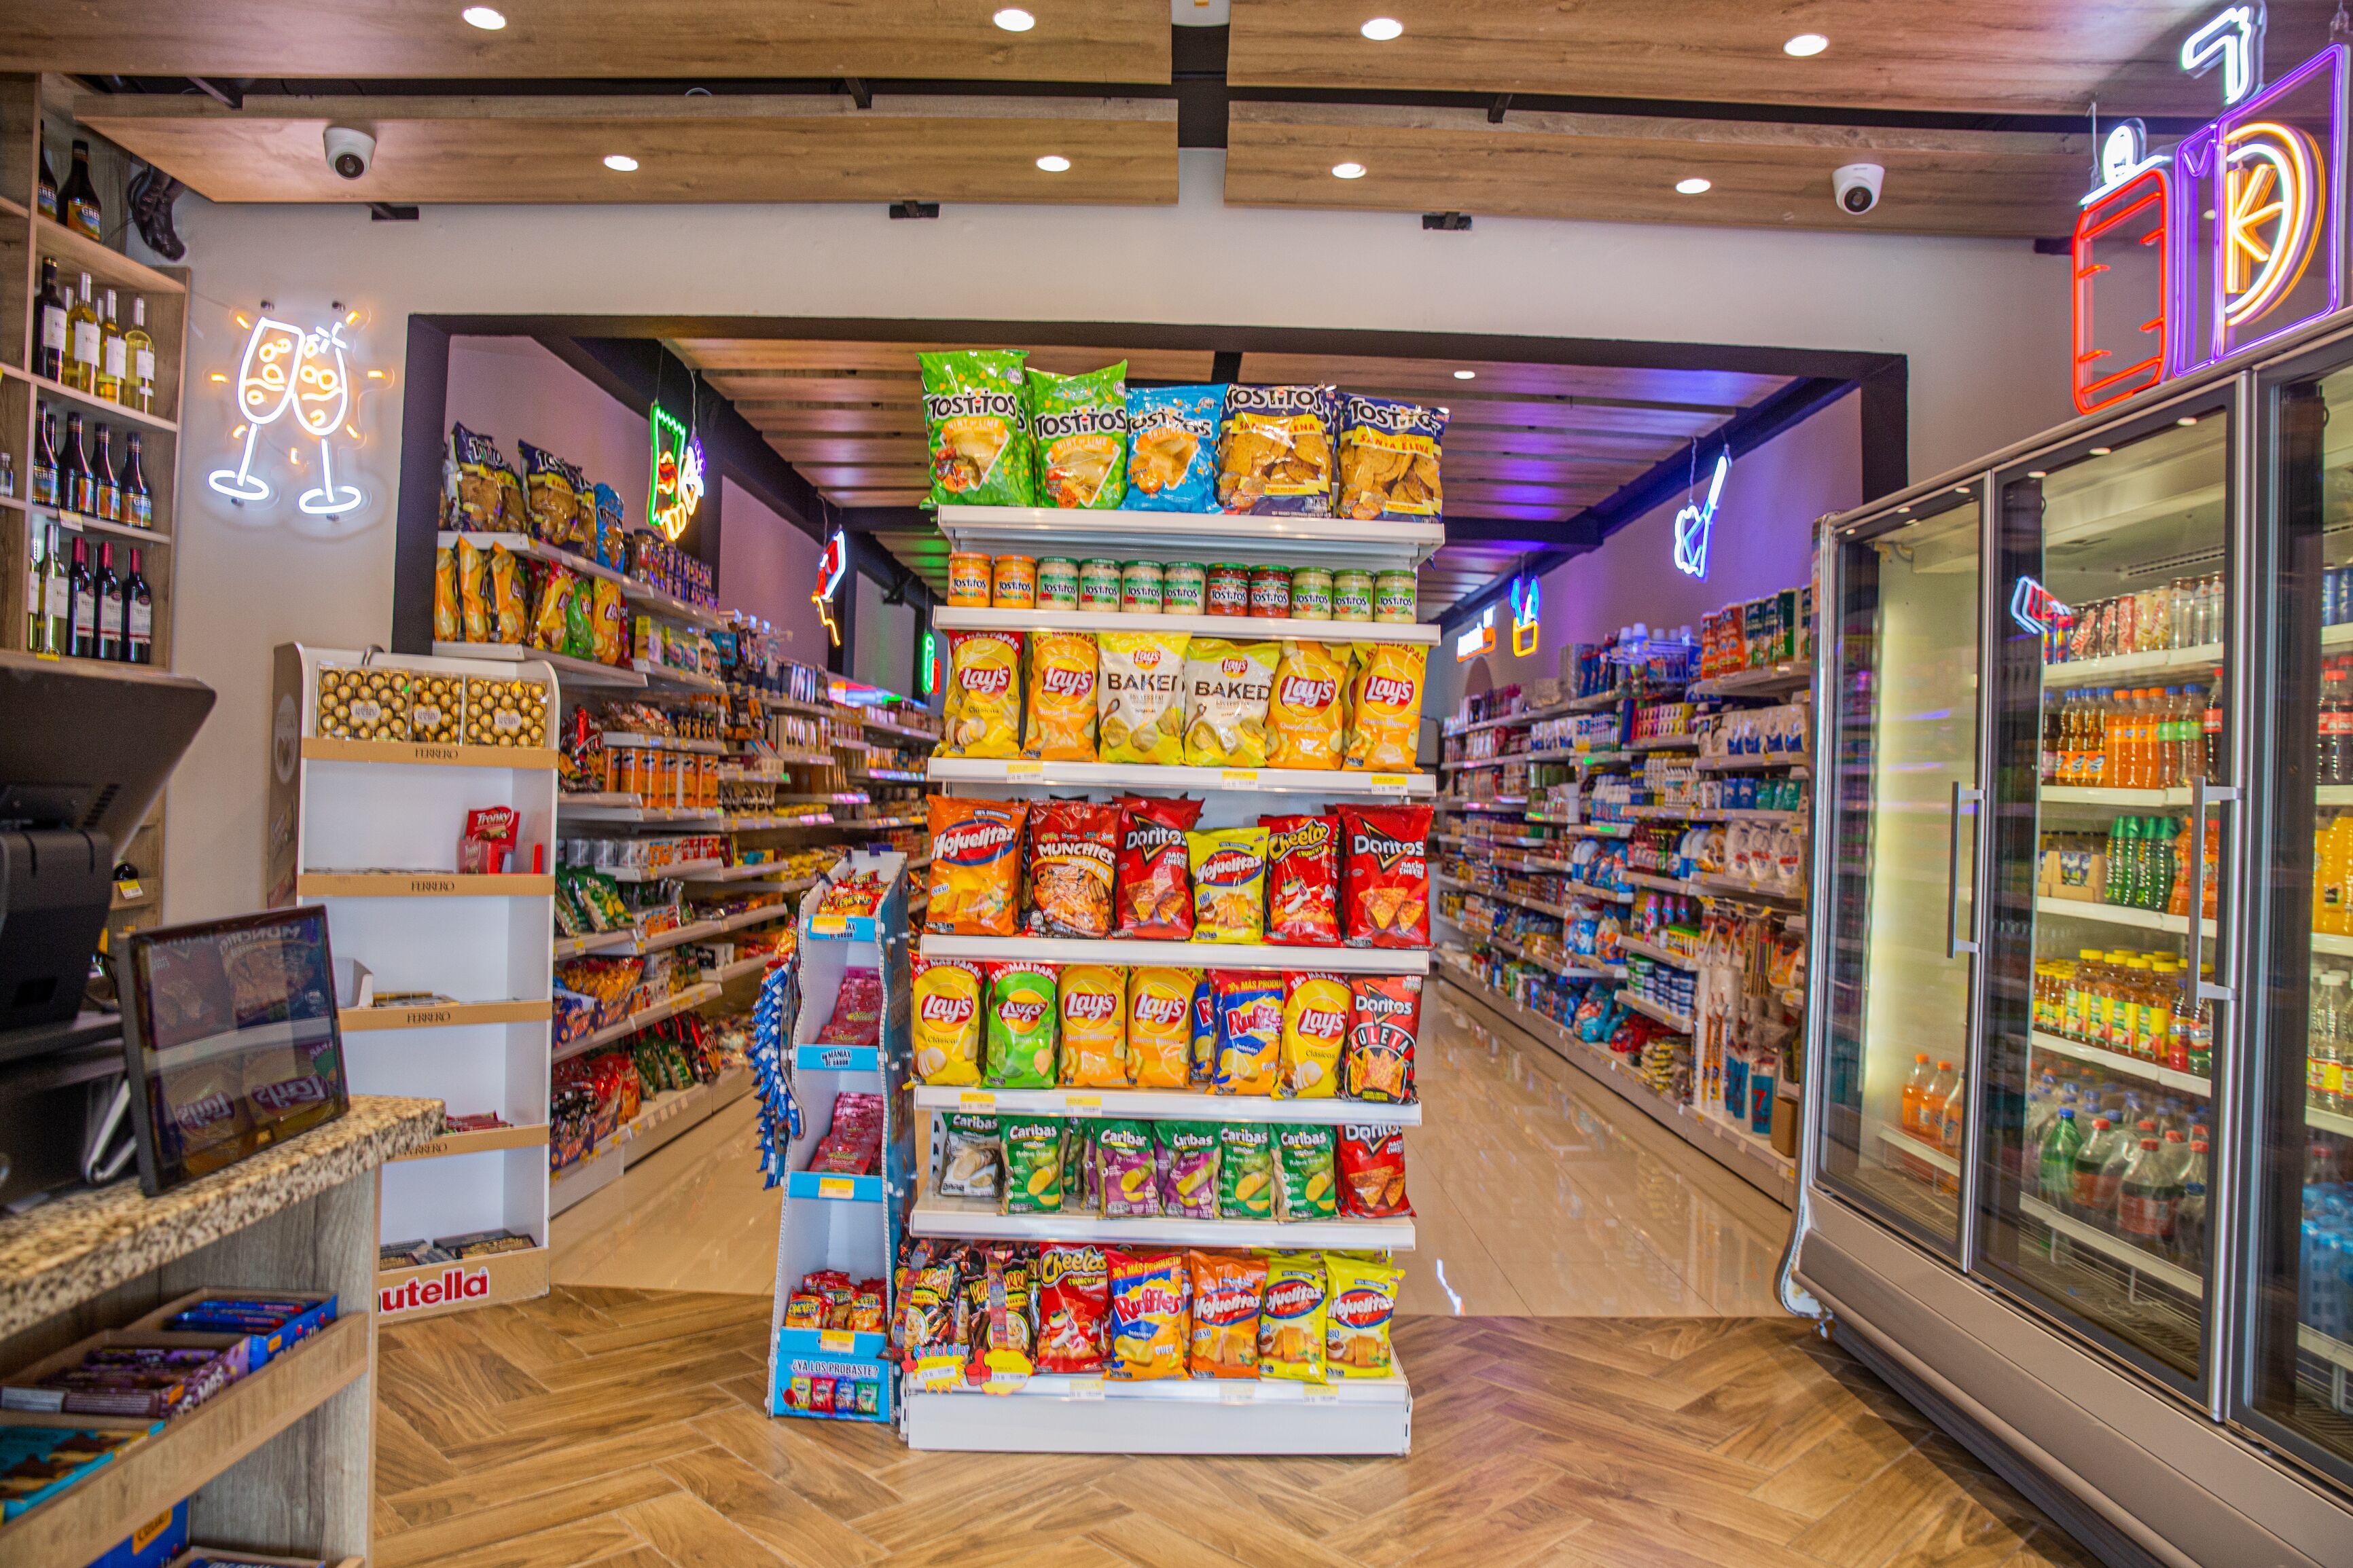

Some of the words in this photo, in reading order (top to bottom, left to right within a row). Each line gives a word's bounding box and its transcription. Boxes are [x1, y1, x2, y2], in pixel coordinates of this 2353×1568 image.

[1396, 643, 1425, 664] PAPAS
[962, 666, 1011, 694] Lay's
[1045, 667, 1093, 697] Lay's
[1195, 681, 1271, 701] BAKED
[1282, 676, 1336, 708] Lay's
[1365, 676, 1413, 706] Lay's
[414, 748, 459, 759] FERRERO
[476, 810, 514, 826] Tronky
[931, 826, 1017, 860] Hojuelitas
[1126, 826, 1188, 850] Doritos
[1354, 835, 1424, 856] Doritos
[1038, 843, 1116, 867] MUNCHIES
[1297, 845, 1323, 857] CRUNCHY
[1196, 854, 1262, 883] Hojuelitas
[411, 881, 455, 892] FERRERO
[931, 883, 950, 896] QUESO
[924, 993, 974, 1024] Lay's
[1066, 992, 1117, 1021] Lay's
[1136, 991, 1186, 1025] Lay's
[1355, 994, 1414, 1016] Doritos
[408, 1010, 450, 1024] FERRERO
[1300, 1008, 1346, 1039] Lay's
[1351, 1026, 1409, 1054] RULETA
[952, 1114, 998, 1131] Caribas
[1009, 1123, 1057, 1141] Caribas
[1172, 1132, 1214, 1148] Caribas
[1221, 1127, 1269, 1144] Caribas
[1281, 1131, 1327, 1147] Caribas
[1041, 1249, 1107, 1287] Cheetos
[1126, 1261, 1143, 1275] MÁS
[1144, 1256, 1182, 1272] PRODUCTO
[380, 1271, 487, 1311] utella
[1067, 1277, 1096, 1287] CRUNCHY
[1113, 1287, 1182, 1326] Ruffles
[1193, 1291, 1261, 1319] Hojuelitas
[1327, 1294, 1395, 1319] Hojuelitas
[1193, 1328, 1212, 1340] QUESO
[913, 1343, 947, 1359] Special
[793, 1360, 808, 1371] ¿YA
[810, 1361, 827, 1372] LOS
[829, 1362, 879, 1378] PROBASTE?
